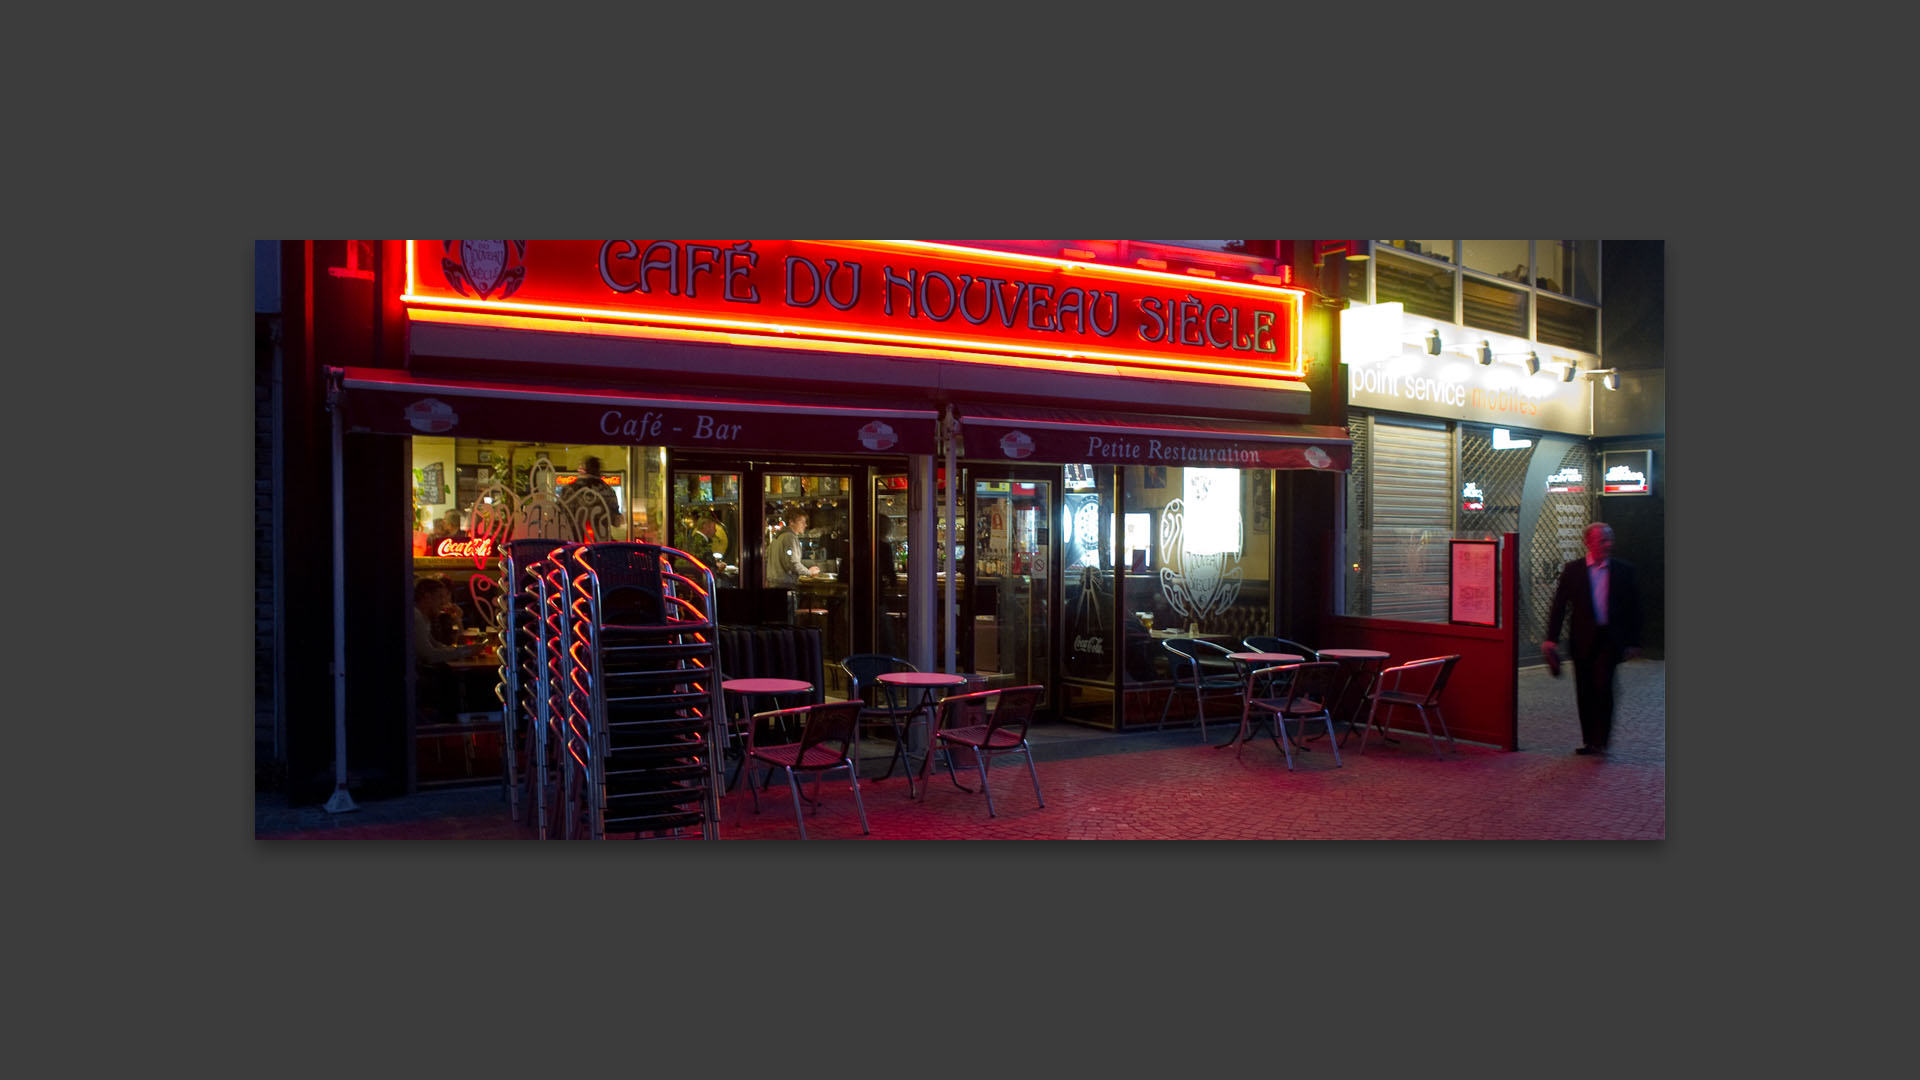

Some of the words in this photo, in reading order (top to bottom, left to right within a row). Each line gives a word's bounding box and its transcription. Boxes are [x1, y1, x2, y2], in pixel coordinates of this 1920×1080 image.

[599, 240, 761, 304] CAFÉ
[785, 256, 862, 311] DU
[883, 265, 1118, 338] NOUVEAU
[1138, 294, 1278, 354] SIÈCLE
[1351, 360, 1400, 398] point
[1405, 374, 1465, 407] service
[600, 410, 664, 442] Café
[693, 415, 742, 441] Bar
[1086, 436, 1141, 460] Petite
[1147, 439, 1260, 463] Restauration
